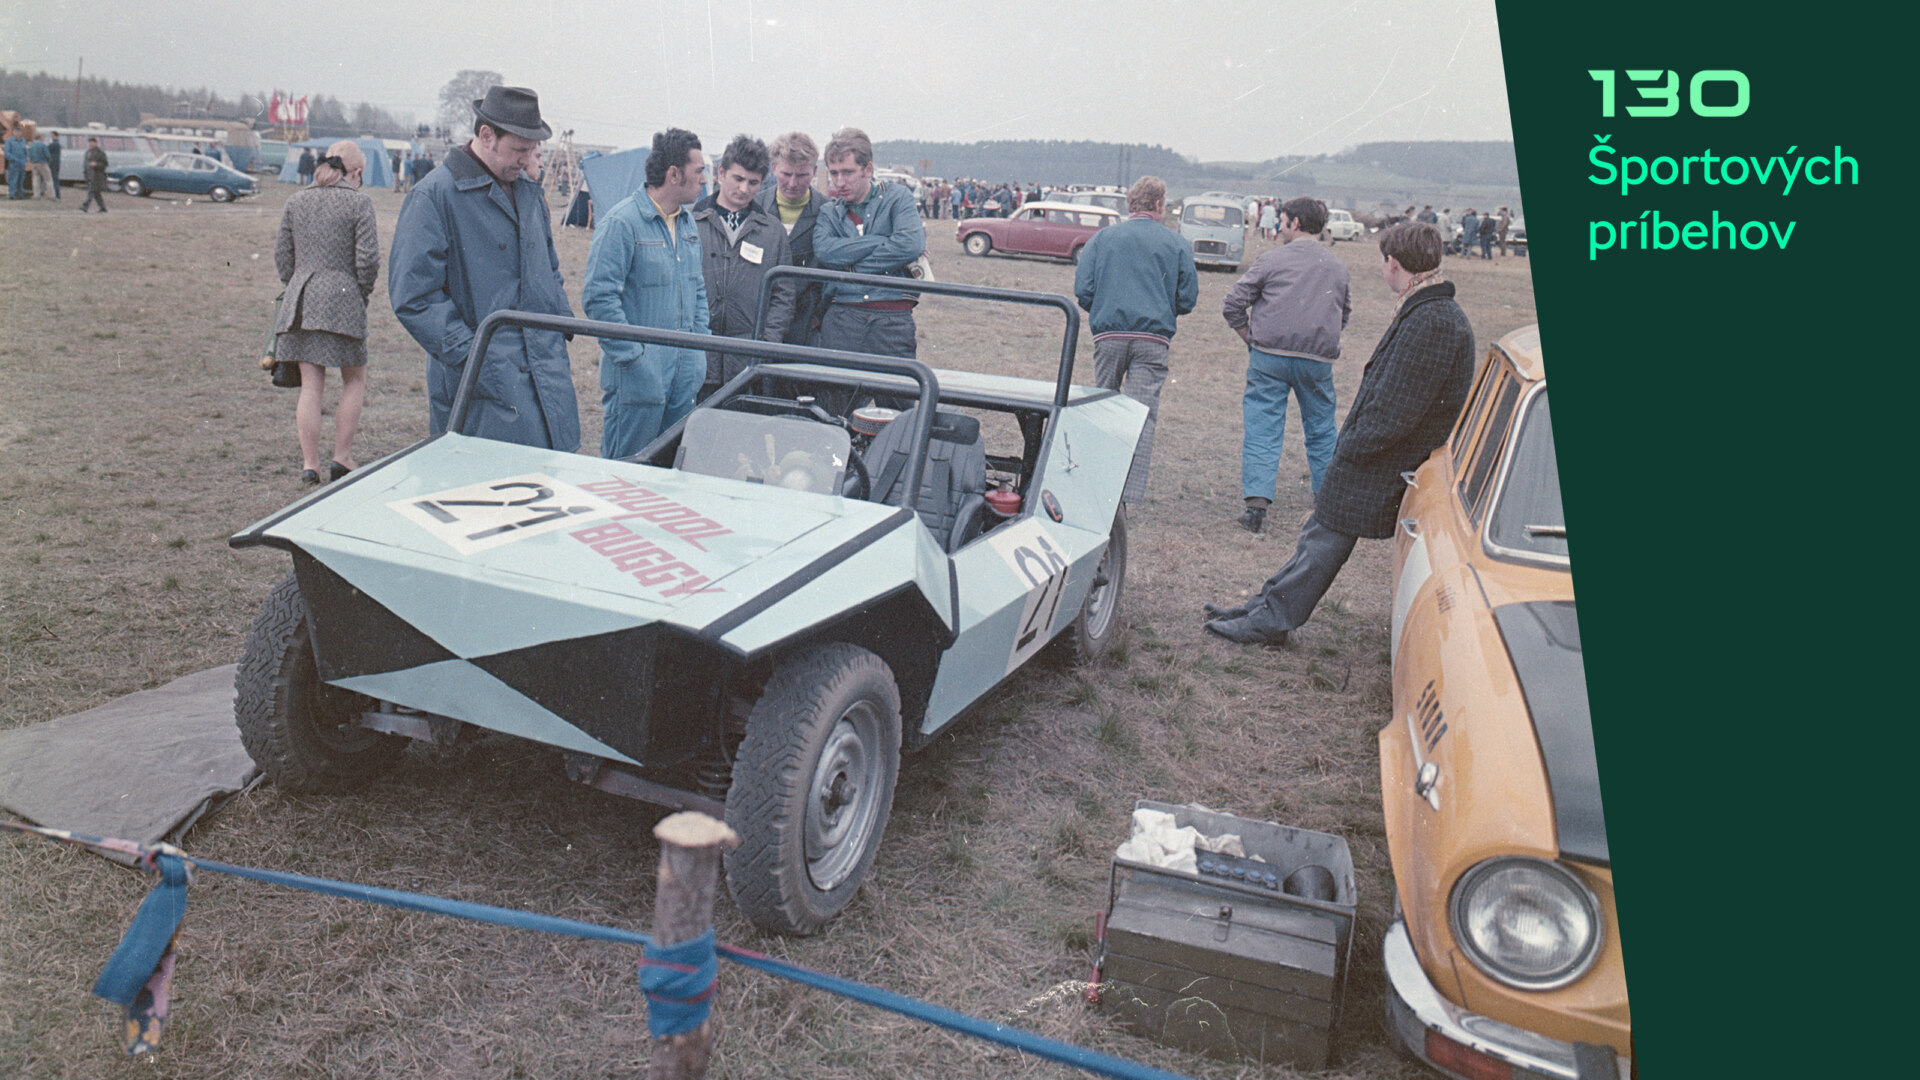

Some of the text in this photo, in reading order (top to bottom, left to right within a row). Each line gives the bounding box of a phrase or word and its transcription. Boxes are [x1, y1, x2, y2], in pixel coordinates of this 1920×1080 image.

[413, 482, 594, 541] 21
[568, 522, 726, 598] BUGGY
[1014, 535, 1068, 652] 21
